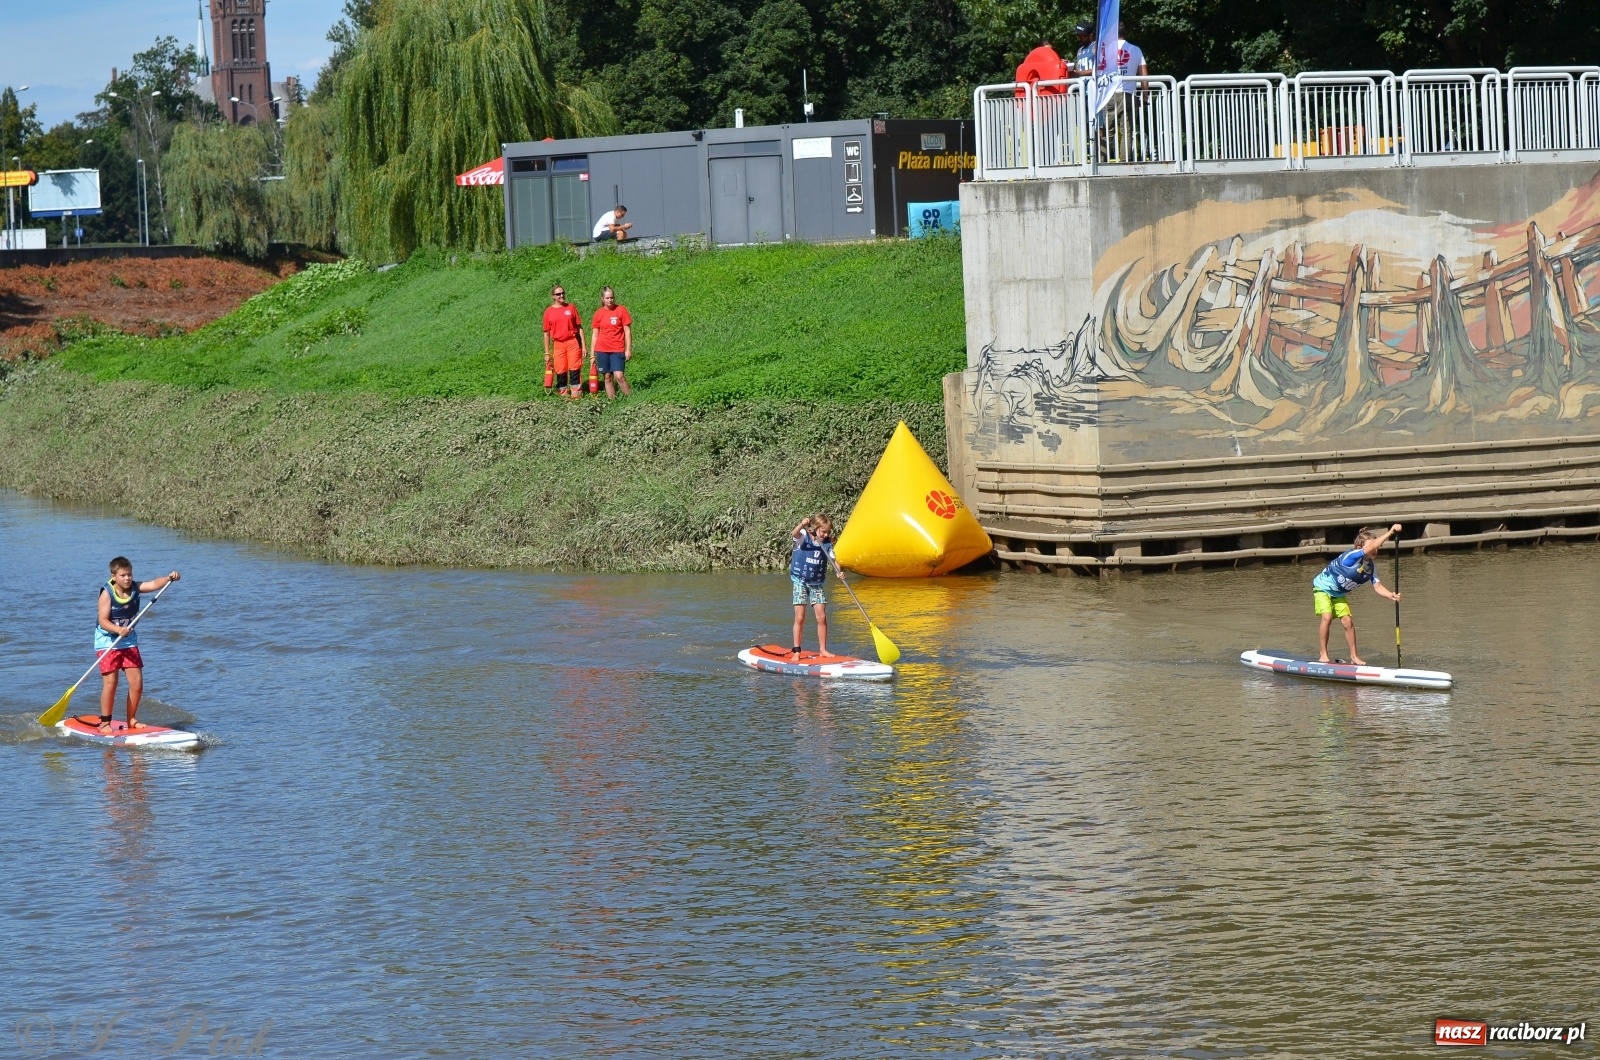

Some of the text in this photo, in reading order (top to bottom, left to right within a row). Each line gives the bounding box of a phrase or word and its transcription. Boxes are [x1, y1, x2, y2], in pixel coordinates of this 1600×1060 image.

[846, 146, 859, 156] WC
[899, 151, 977, 173] Plaża miejska
[922, 209, 940, 220] OD
